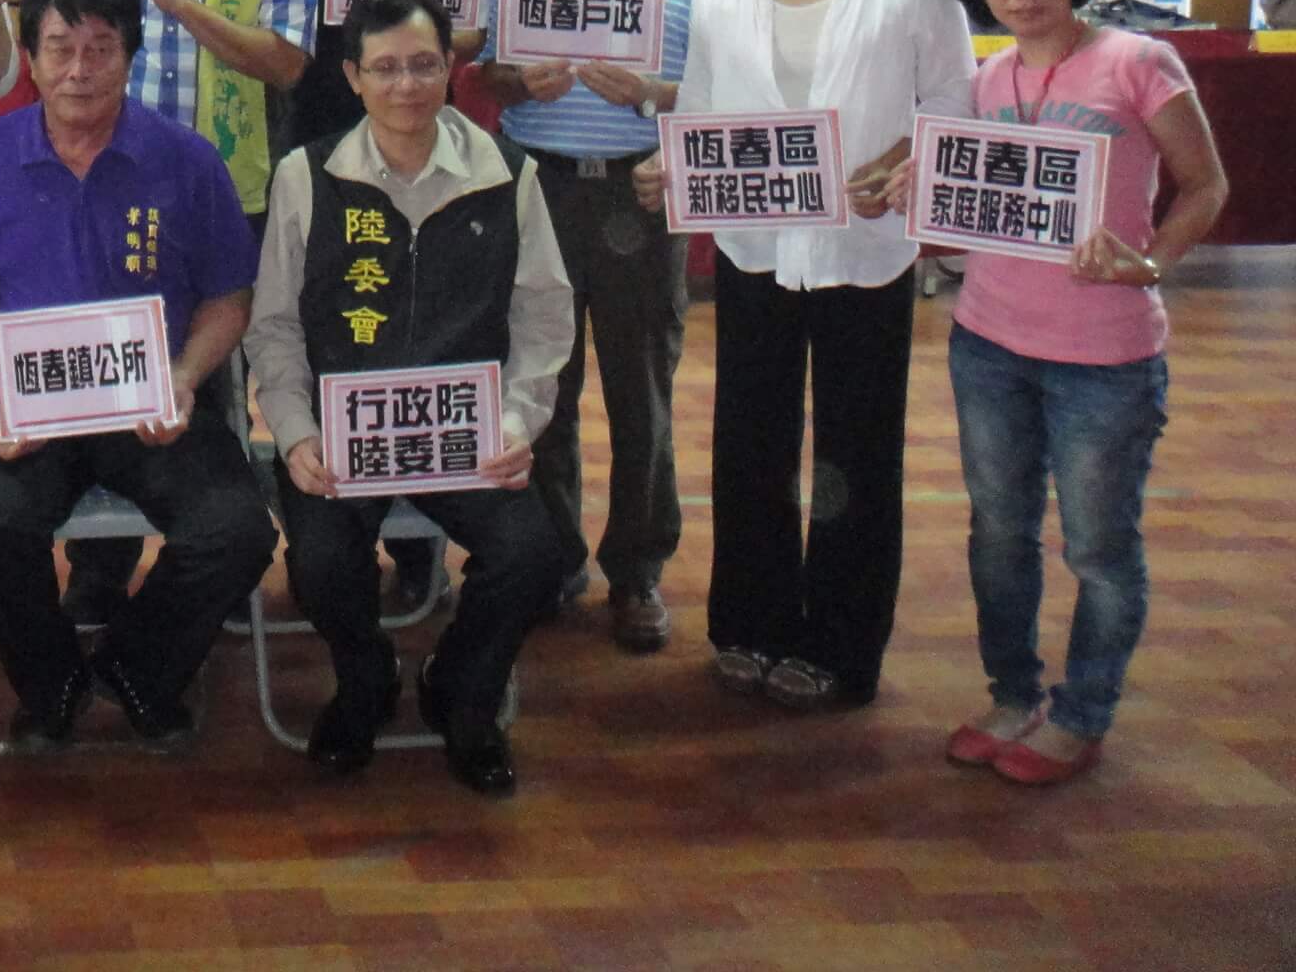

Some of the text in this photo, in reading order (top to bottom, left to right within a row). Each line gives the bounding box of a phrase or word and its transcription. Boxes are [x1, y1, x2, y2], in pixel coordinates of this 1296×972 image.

[682, 124, 819, 170] 恆春區
[935, 134, 1081, 195] 恆春區
[687, 169, 825, 215] 新移民中心
[929, 182, 1078, 245] 家庭服務中心
[341, 207, 392, 345] 陸委會
[13, 339, 149, 396] 恆春鎮公所
[345, 381, 479, 433] 行政院
[347, 428, 480, 479] 陸委會
